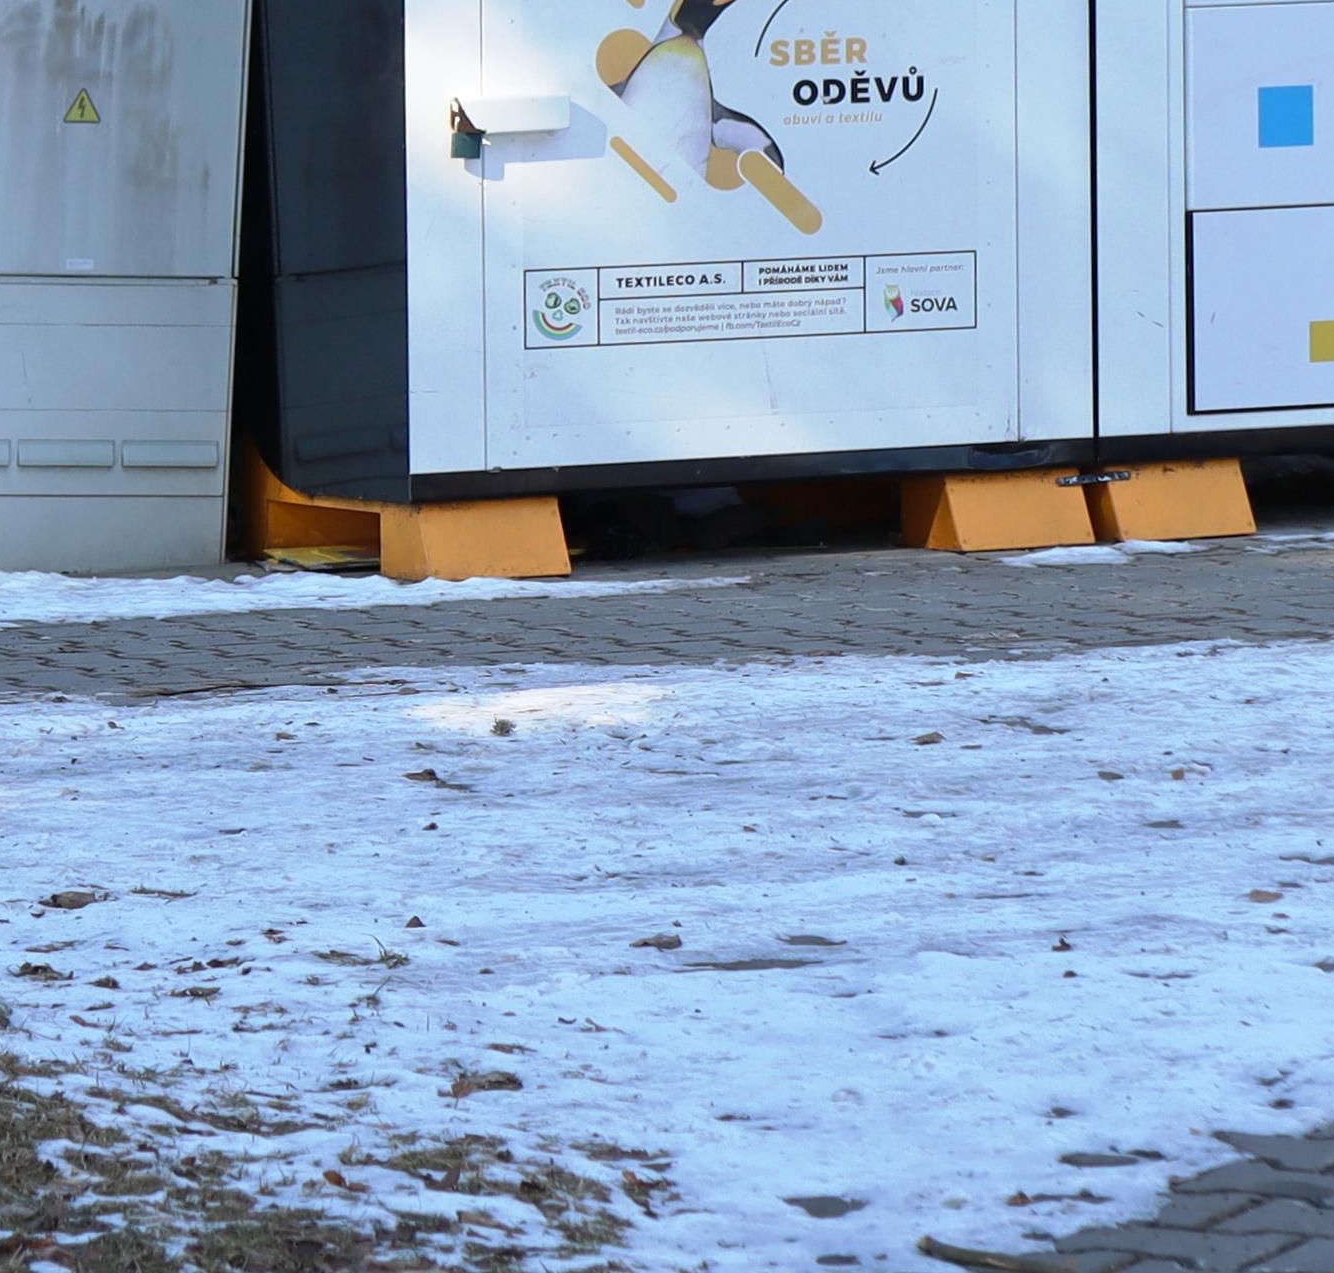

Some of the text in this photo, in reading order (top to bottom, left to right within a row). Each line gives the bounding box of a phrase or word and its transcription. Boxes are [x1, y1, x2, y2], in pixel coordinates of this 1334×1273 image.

[769, 30, 867, 67] SBĚR
[793, 66, 924, 106] ODĚVŮ
[783, 111, 883, 125] obuvi a textilu
[759, 263, 849, 274] POMÁHÁME LIDEM
[876, 266, 898, 275] Jsme
[616, 274, 726, 289] TEXTILECO A.S.
[763, 276, 802, 286] PŘÍRODĚ
[804, 274, 826, 284] DÍKY
[828, 274, 849, 282] VÁM
[739, 301, 761, 310] nebo
[763, 300, 785, 308] máte
[787, 299, 812, 309] dobrý
[910, 297, 958, 313] SOVA
[615, 317, 630, 325] Tak
[675, 314, 695, 322] naše
[734, 311, 768, 320] stránky
[768, 310, 791, 319] nebo
